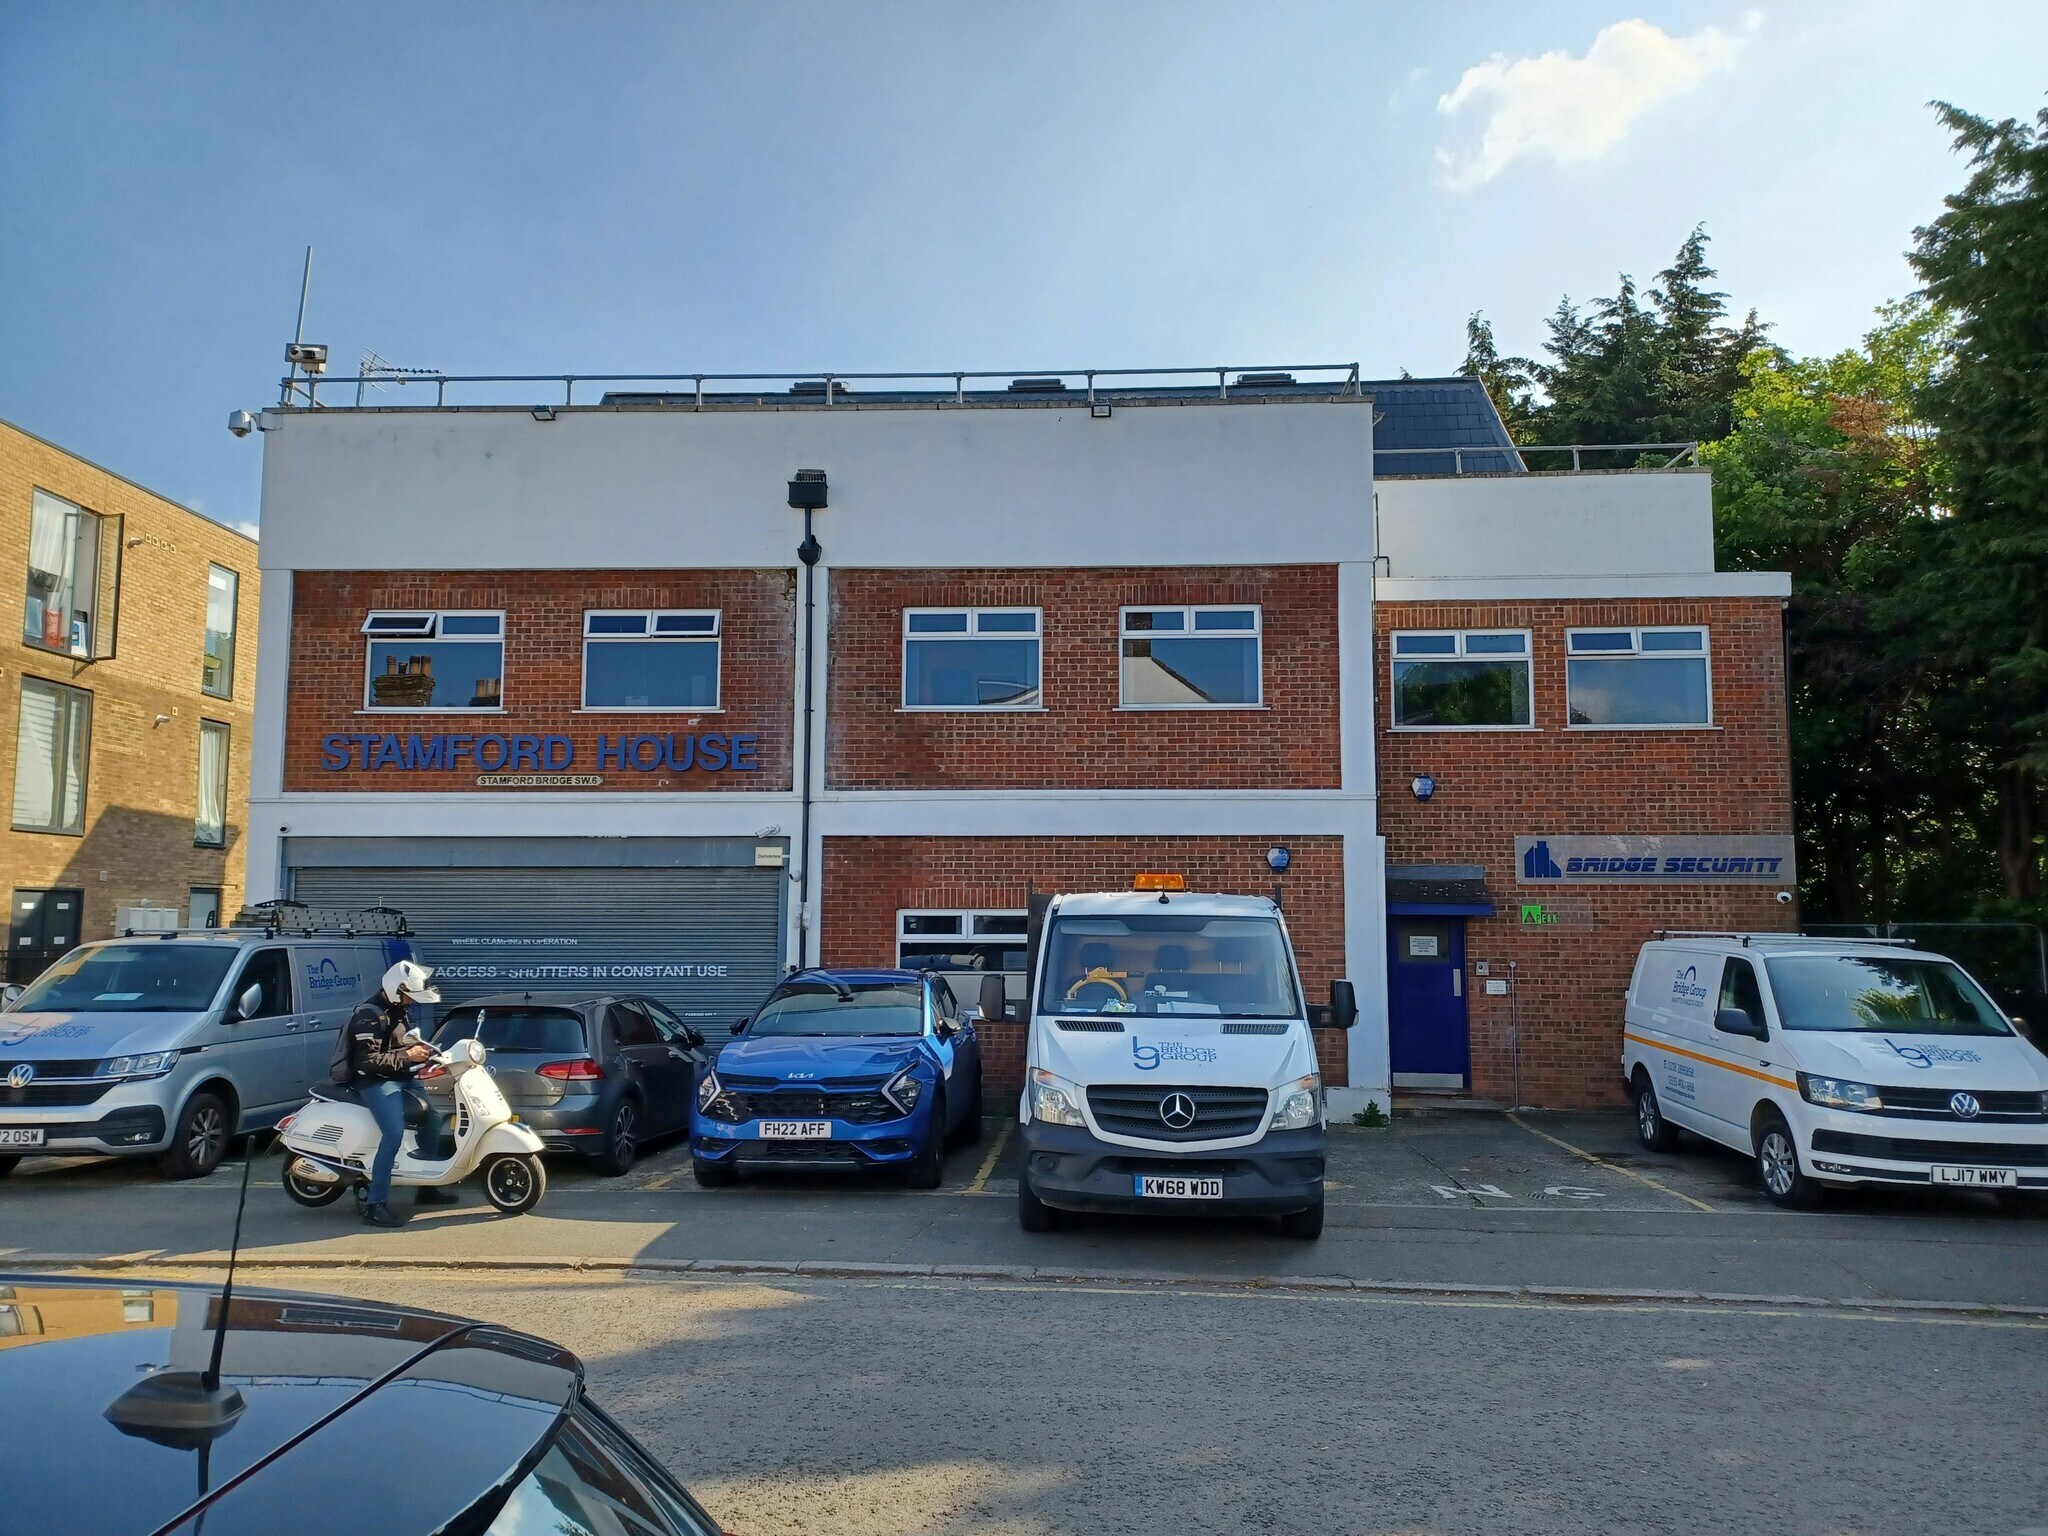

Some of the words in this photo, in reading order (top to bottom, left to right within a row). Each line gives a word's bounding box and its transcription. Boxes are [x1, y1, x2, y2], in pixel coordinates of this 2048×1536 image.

[321, 732, 574, 771] STAMFORD
[596, 733, 758, 772] HOUSE
[480, 776, 534, 785] STAMFORD
[535, 776, 572, 785] BRIDGE
[574, 776, 598, 785] SW.6
[1566, 857, 1656, 873] BRIDGE
[1663, 857, 1783, 873] SECURITY
[306, 964, 319, 974] The
[436, 966, 497, 978] ACCESS
[508, 966, 588, 978] SHUTTERS
[592, 966, 607, 977] IN
[611, 966, 693, 977] CONSTANT
[697, 966, 728, 977] USE
[309, 976, 333, 990] Bridge
[334, 975, 356, 987] Group
[1161, 1046, 1216, 1056] BRIDGE
[1161, 1053, 1217, 1063] GROUP
[764, 1123, 797, 1136] FH22
[800, 1123, 825, 1136] AFF
[13, 1131, 38, 1142] OSW
[1941, 1168, 1974, 1183] LJ17
[1979, 1170, 2007, 1184] WMY
[1145, 1179, 1185, 1195] KW68
[1190, 1181, 1219, 1195] WDD
